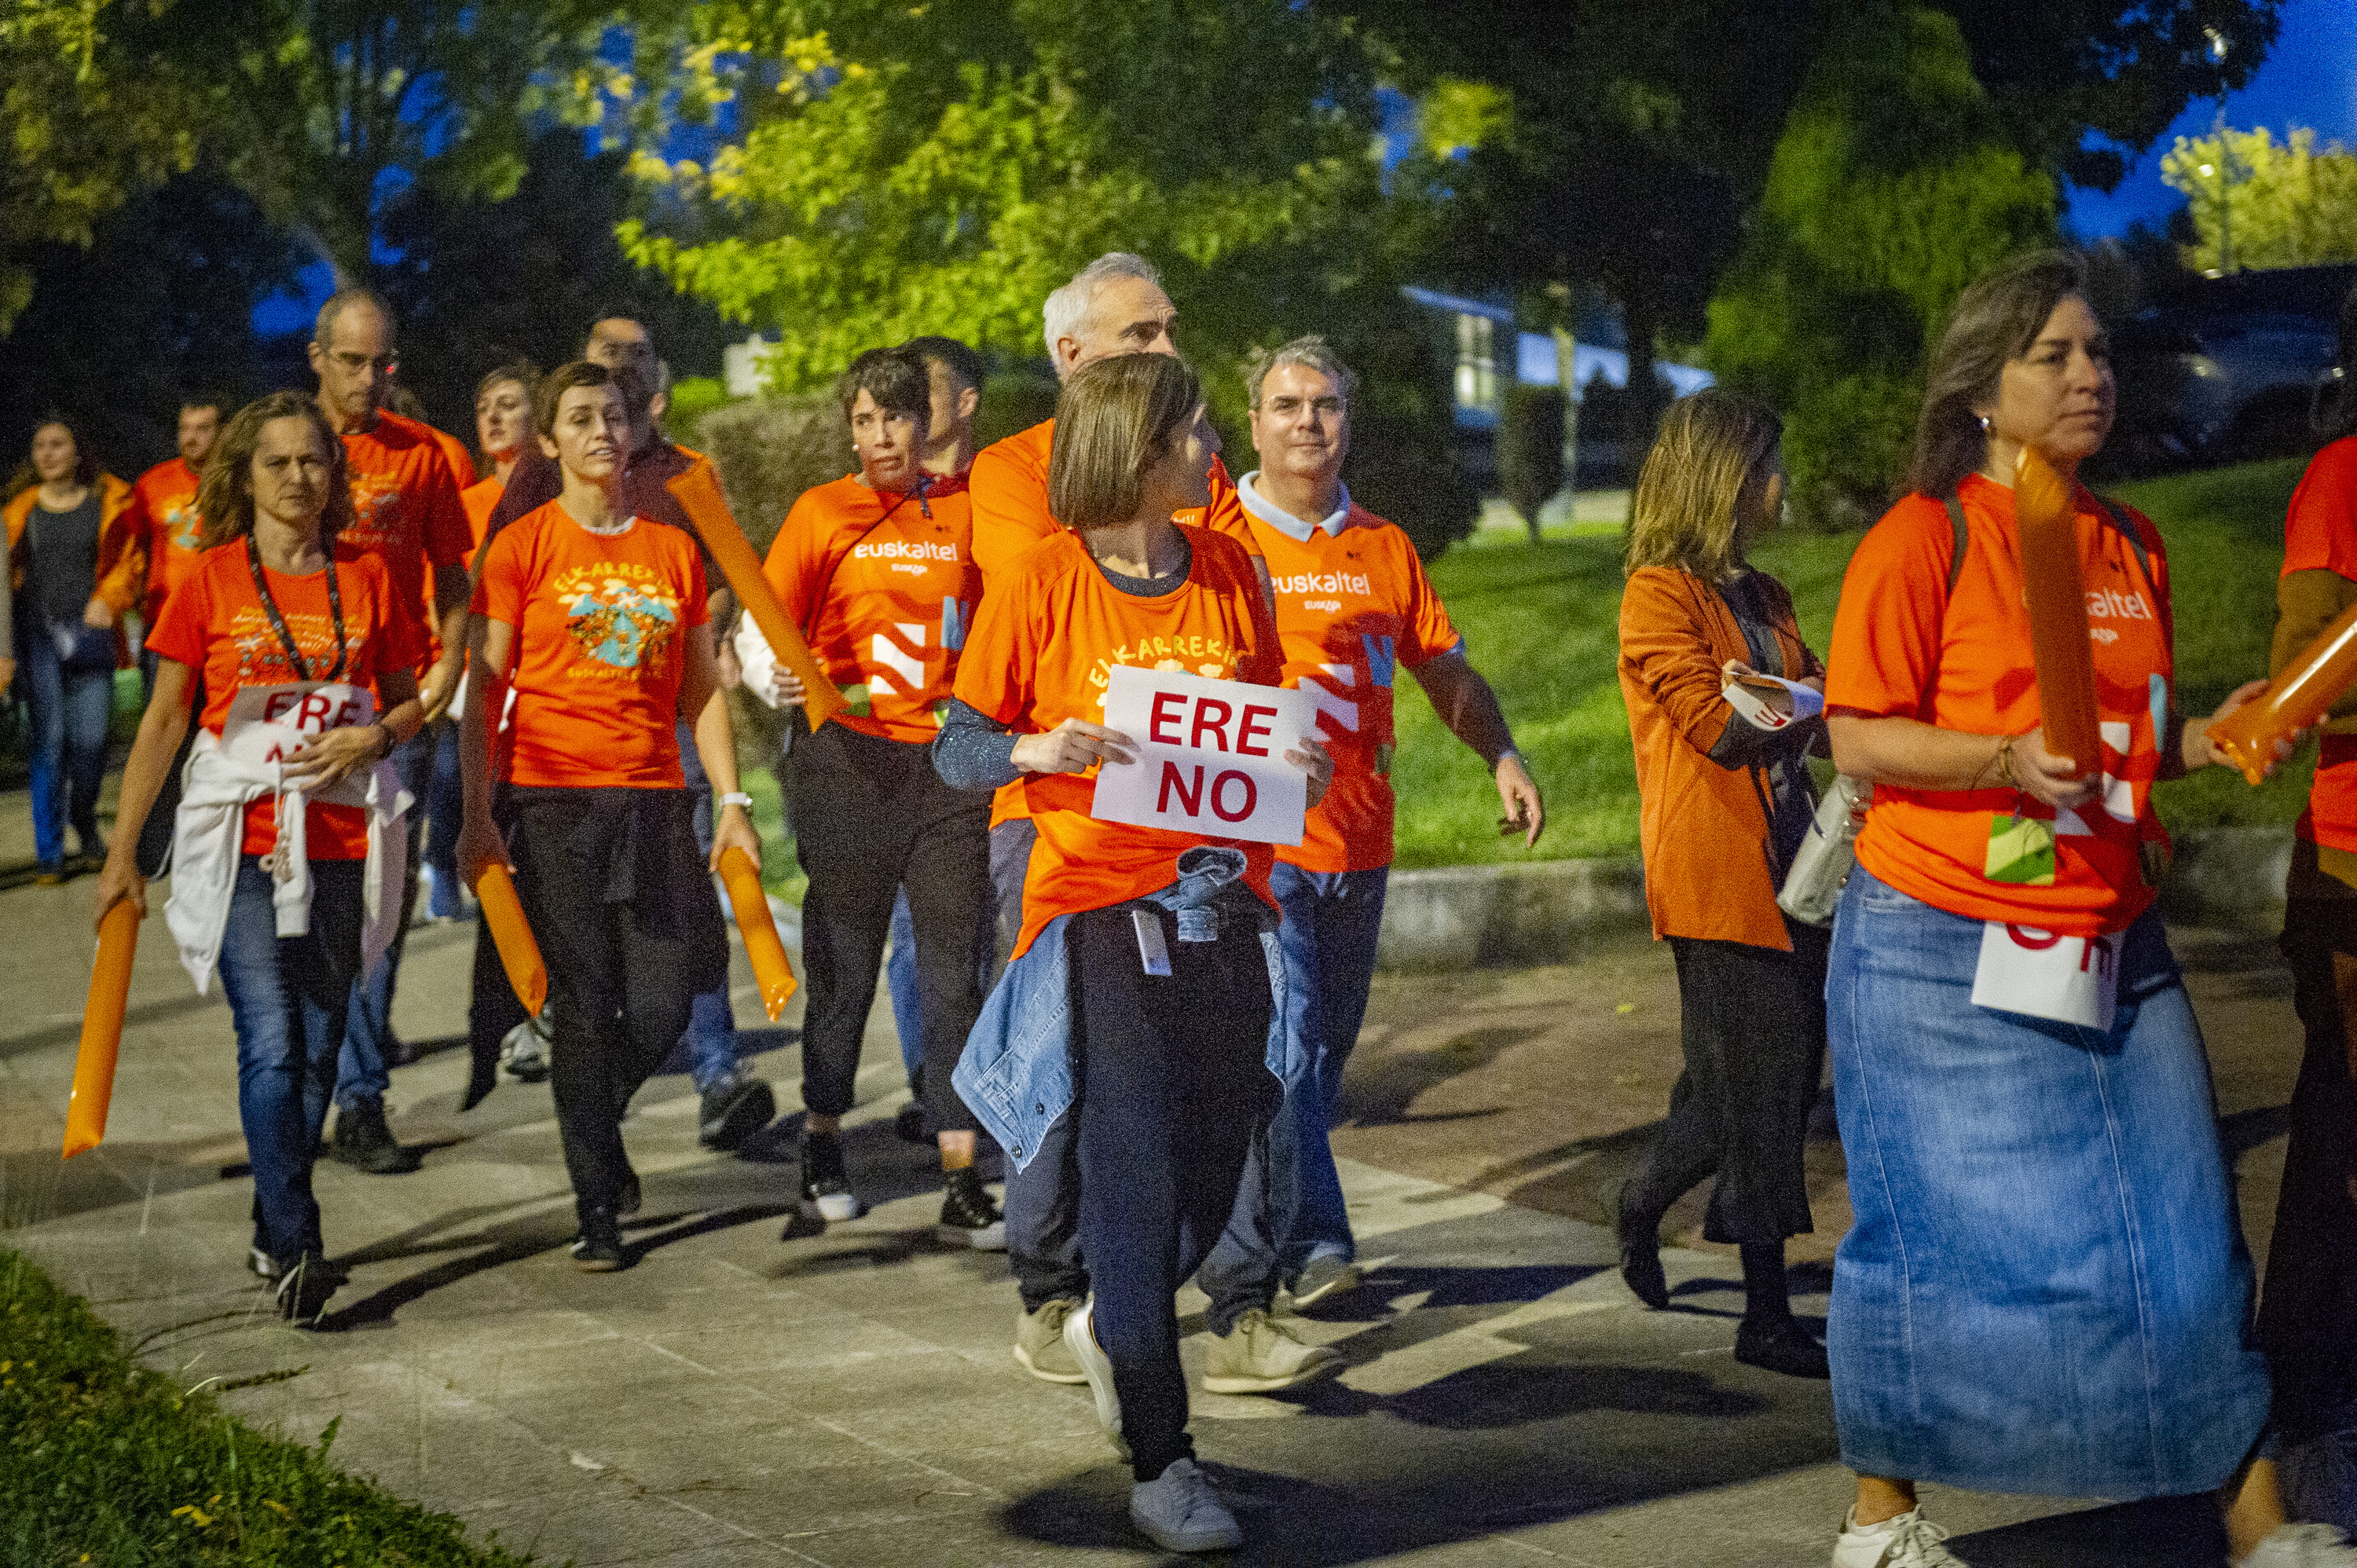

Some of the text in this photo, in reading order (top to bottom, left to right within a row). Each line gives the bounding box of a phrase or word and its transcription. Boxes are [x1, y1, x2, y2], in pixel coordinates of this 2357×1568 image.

[854, 540, 959, 562] euskaltel
[2084, 587, 2153, 620] altel
[1149, 691, 1278, 757] ERE
[1157, 760, 1258, 823] NO
